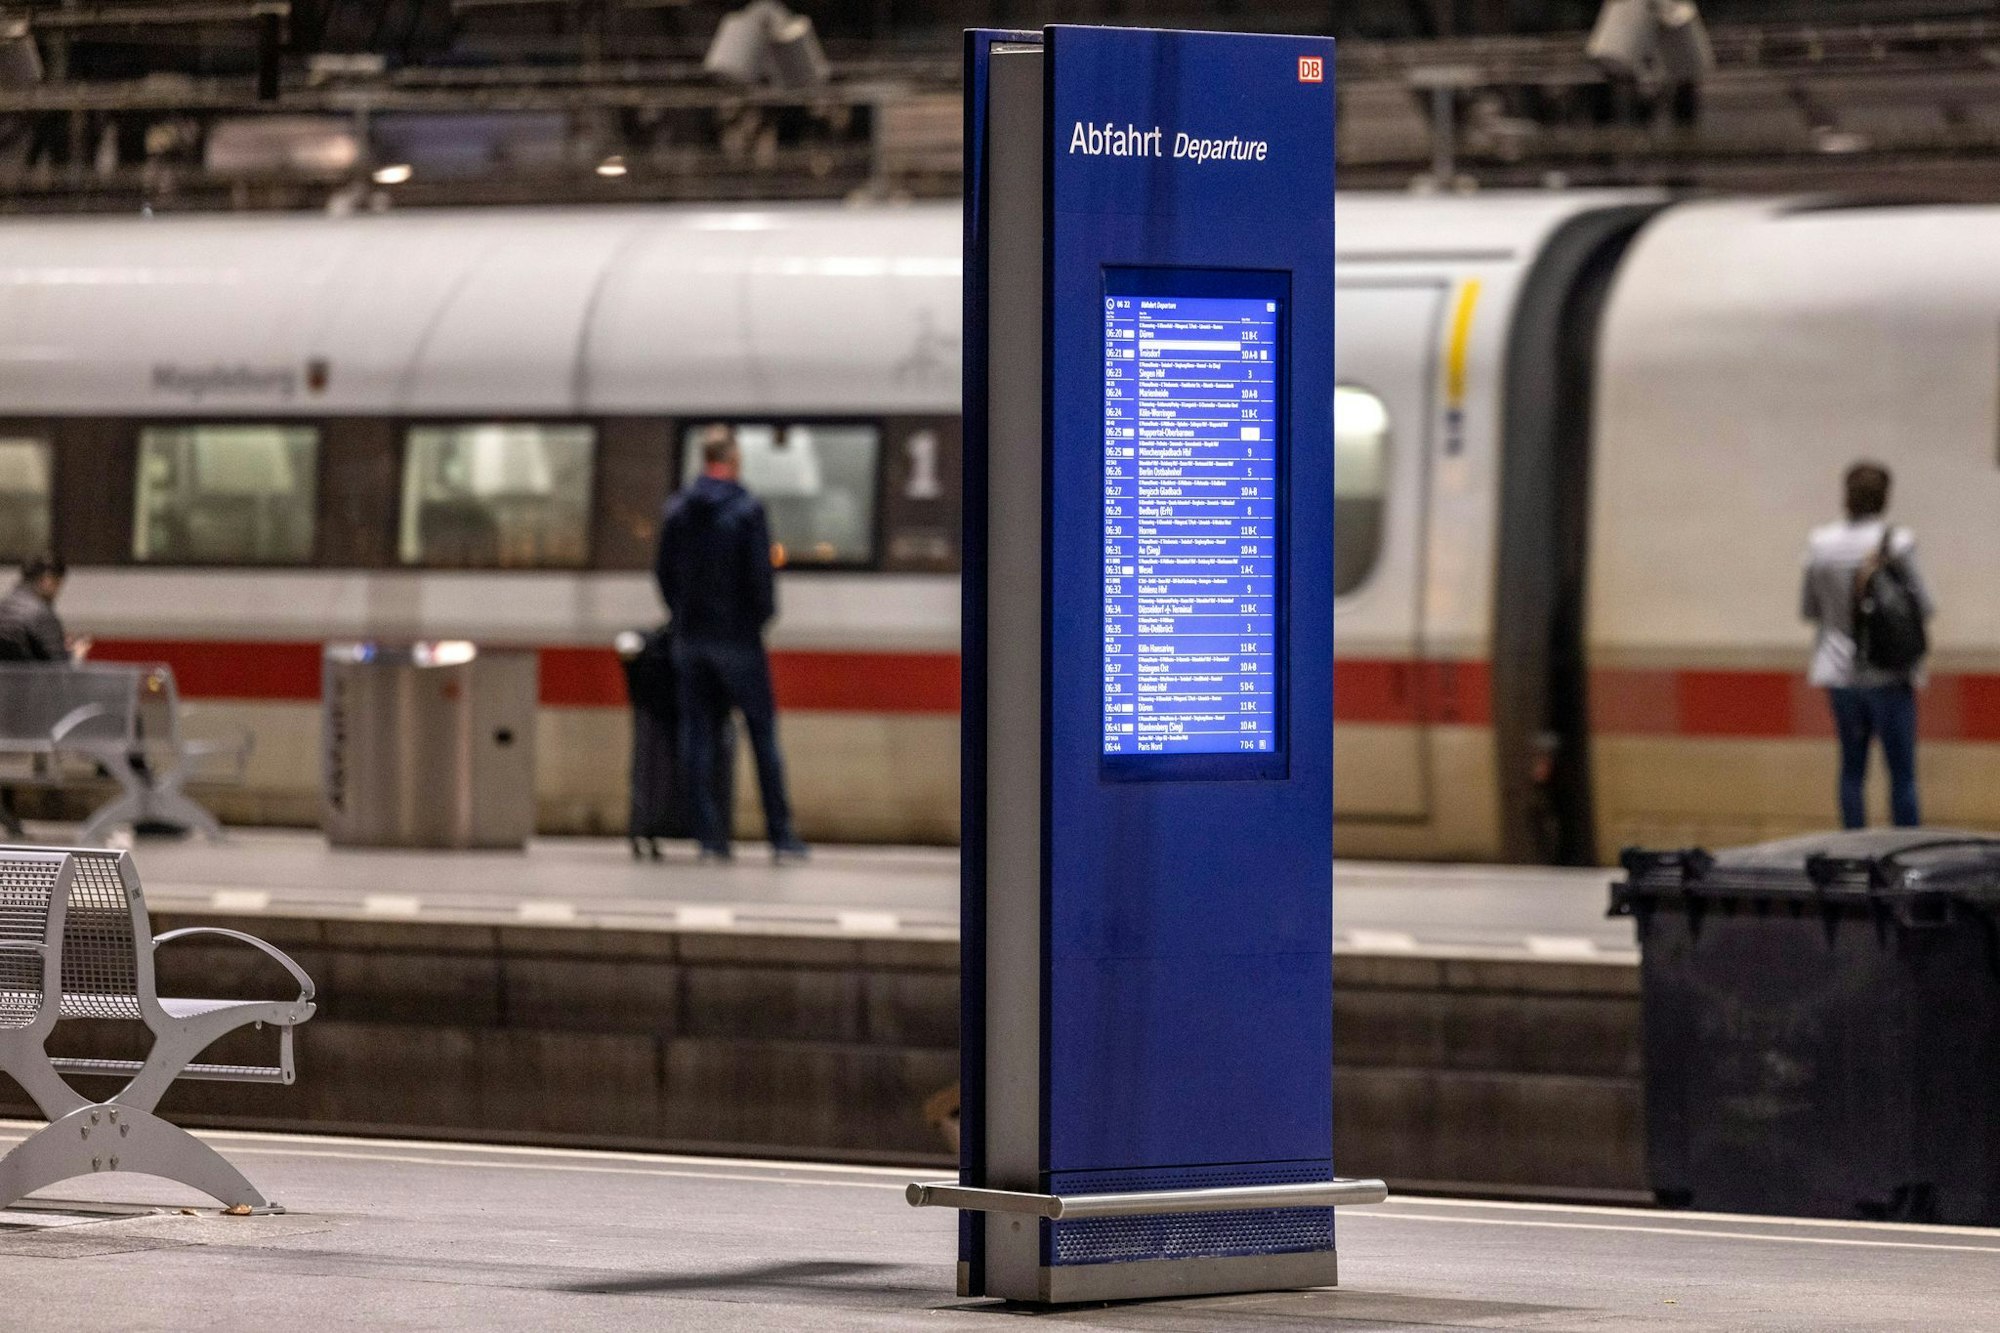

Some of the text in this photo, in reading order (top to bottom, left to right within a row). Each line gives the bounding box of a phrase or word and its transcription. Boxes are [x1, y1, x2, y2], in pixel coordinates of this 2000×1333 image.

[1300, 59, 1321, 80] DB
[1069, 121, 1268, 164] Abfahrt Departure
[1106, 329, 1122, 338] 06:20
[1242, 330, 1249, 339] 11
[1106, 349, 1122, 357] 06:21
[1242, 350, 1249, 359] 10
[1106, 368, 1122, 377] 06:23
[1139, 369, 1165, 379] Siegen Hbf
[1248, 370, 1252, 378] 3
[1106, 388, 1122, 397] 06:24
[1139, 388, 1169, 397] Marienheide
[1242, 389, 1249, 398] 10
[1106, 408, 1122, 416] 06:24
[1139, 407, 1176, 419] Köln-Worringen
[1242, 408, 1248, 417] 11
[1106, 427, 1122, 436] 06:25
[1139, 427, 1194, 438] Wuppertal-Oberbarmen
[1106, 447, 1122, 456] 06:25
[1182, 448, 1192, 456] Hbf
[1248, 448, 1252, 456] 9
[1106, 467, 1122, 475] 06:26
[1139, 467, 1182, 476] Berlin Ostbahnhof
[1248, 467, 1252, 476] 5
[1106, 486, 1122, 495] 06:27
[1139, 487, 1182, 497] Bergisch Gladbach
[1241, 486, 1248, 495] 10
[1106, 506, 1122, 514] 06:29
[1138, 506, 1173, 517] Bedburg (Erft)
[1247, 506, 1252, 515] 8
[1105, 526, 1122, 534] 06:30
[1241, 526, 1248, 534] 11
[1105, 545, 1121, 554] 06:31
[1138, 545, 1161, 556] Au (Sieg)
[1241, 545, 1248, 554] 10
[1105, 565, 1121, 573] 06:31
[1138, 565, 1153, 574] Wesel
[1241, 564, 1244, 573] 1
[1105, 585, 1121, 593] 06:32
[1138, 585, 1168, 594] Koblenz Hbf
[1247, 584, 1251, 593] 9
[1105, 604, 1121, 613] 06:34
[1138, 604, 1193, 614] Düsseldorf Terminal
[1241, 604, 1248, 612] 11
[1105, 624, 1121, 632] 06:35
[1138, 624, 1174, 633] Köln-Dellbrück
[1247, 623, 1251, 632] 3
[1105, 644, 1121, 652] 06:37
[1138, 643, 1150, 653] Köln
[1241, 642, 1247, 651] 11
[1105, 663, 1121, 672] 06:37
[1138, 663, 1169, 674] Ratingen Ost
[1240, 662, 1248, 671] 10
[1105, 683, 1121, 691] 06:38
[1138, 683, 1167, 692] Koblenz Hbf
[1240, 682, 1244, 690] 5
[1105, 702, 1122, 711] 06:40
[1240, 701, 1247, 710] 11
[1105, 722, 1121, 731] 06:41
[1138, 722, 1183, 733] Blankenberg (Sieg)
[1240, 720, 1248, 729] 10
[1105, 742, 1121, 750] 06:44
[1138, 742, 1162, 751] Paris Nord
[1240, 740, 1244, 749] 7
